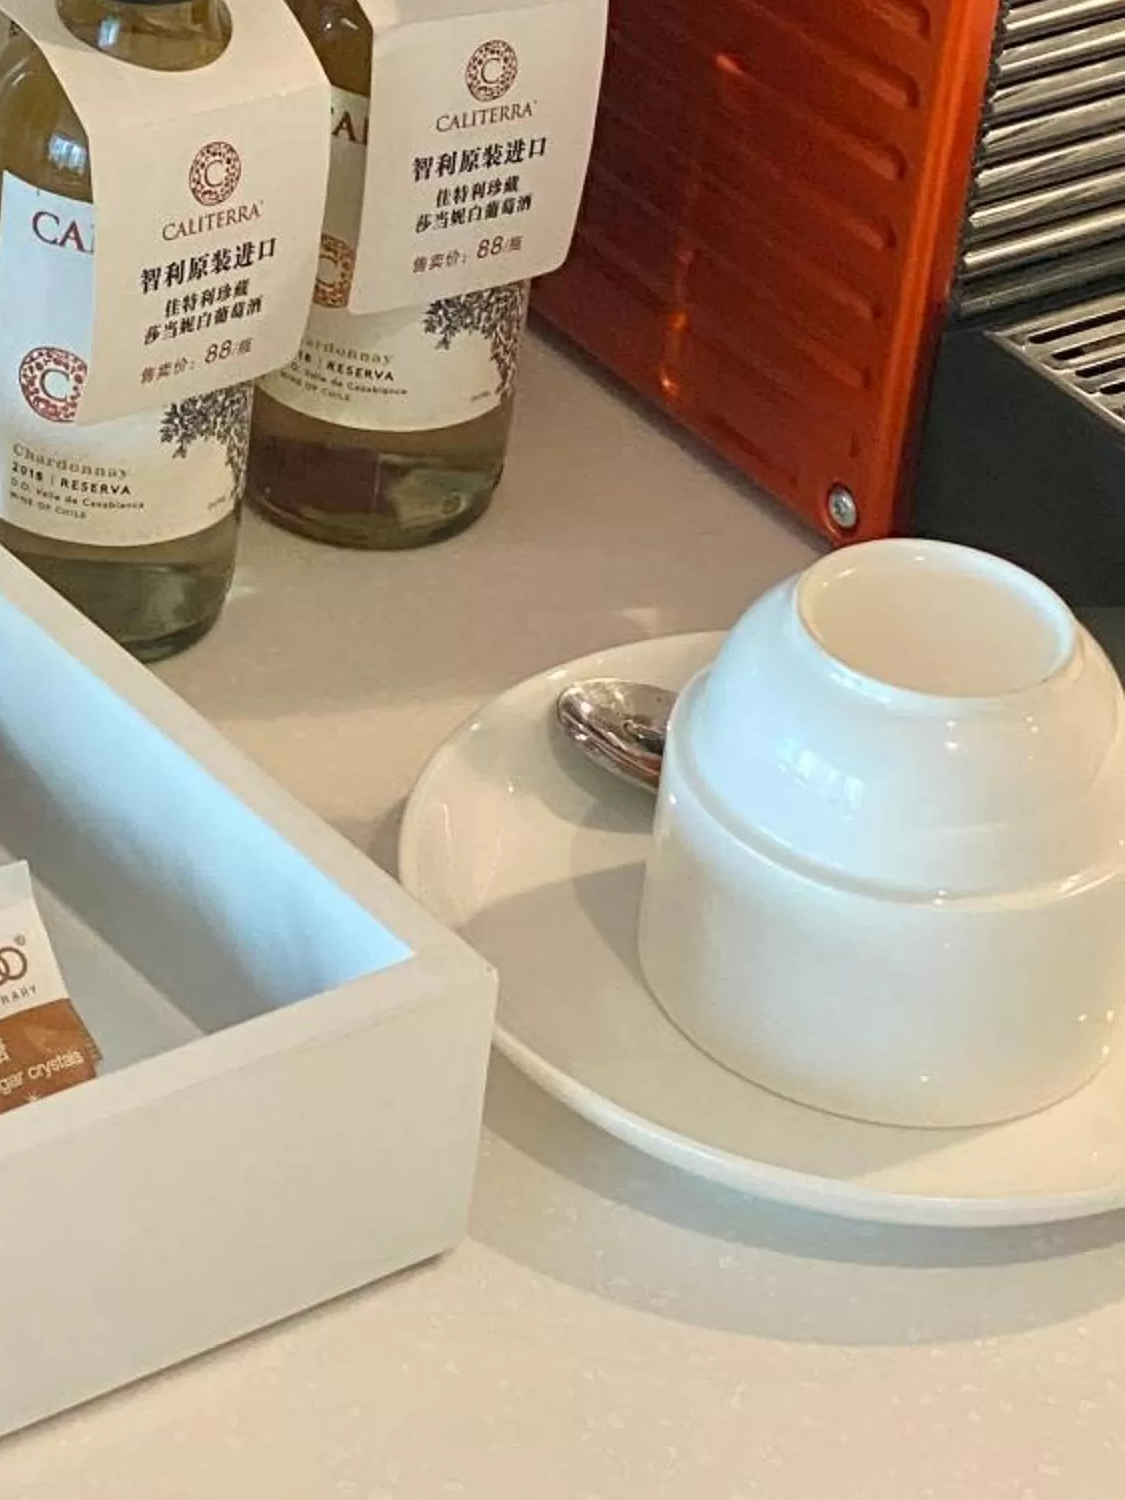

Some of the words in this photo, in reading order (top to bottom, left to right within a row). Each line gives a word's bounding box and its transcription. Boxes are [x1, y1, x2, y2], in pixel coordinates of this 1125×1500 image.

[435, 101, 534, 133] CALITERRA
[412, 136, 548, 183] 智利原装进口
[162, 201, 261, 242] CALITERRA
[415, 194, 533, 234] 莎当妮白葡萄酒
[140, 237, 277, 295] 智利原装进口
[143, 295, 264, 346] 莎当妮白葡萄酒
[327, 361, 394, 381] RESERVA
[61, 477, 131, 496] RESERVA
[27, 1049, 85, 1080] crystals
